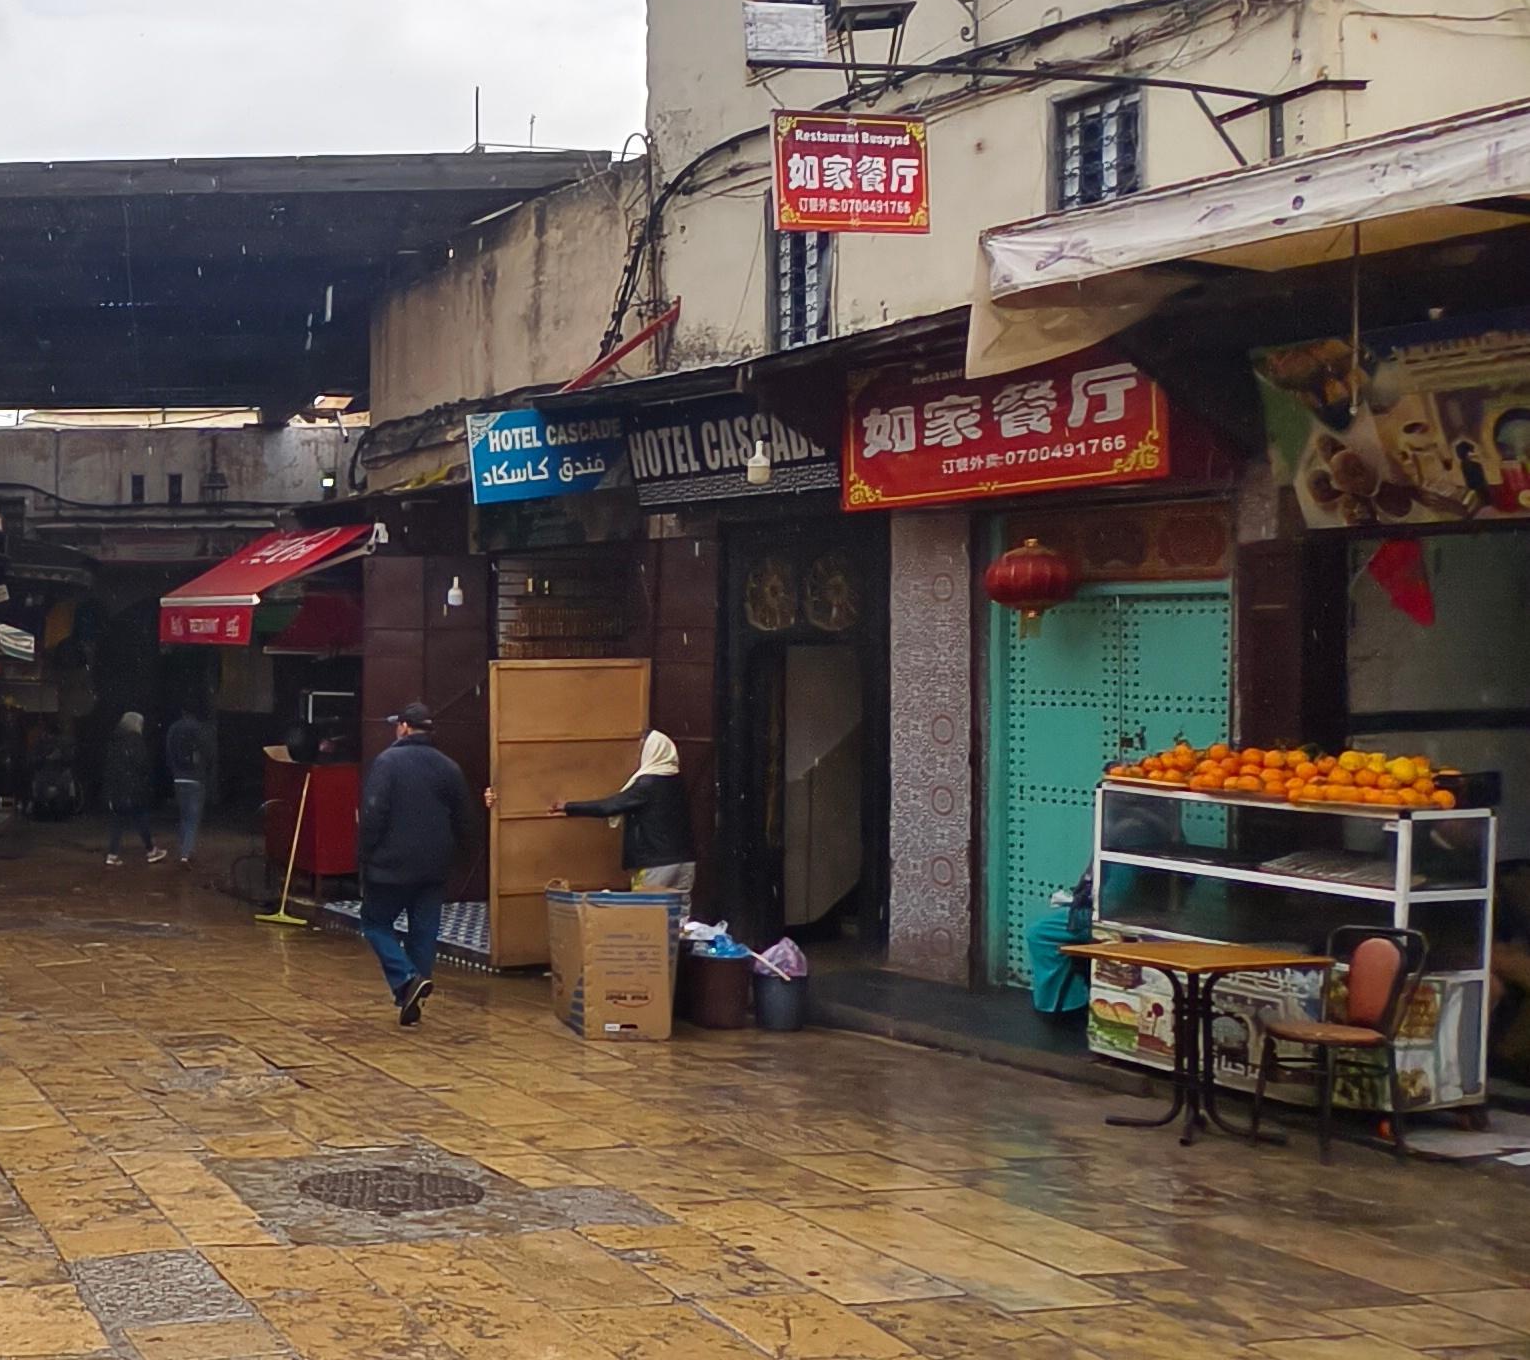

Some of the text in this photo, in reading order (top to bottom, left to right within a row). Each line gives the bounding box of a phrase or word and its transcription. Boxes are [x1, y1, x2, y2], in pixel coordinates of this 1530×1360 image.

[795, 129, 859, 144] Restaurant
[787, 153, 919, 194] 如家餐厅
[912, 367, 964, 385] Restaur
[862, 362, 1139, 458] 如家餐厅
[488, 418, 623, 452] HOTEL CASCADE
[629, 425, 700, 479] HOTEL
[481, 452, 606, 487] فندق كاسكاد
